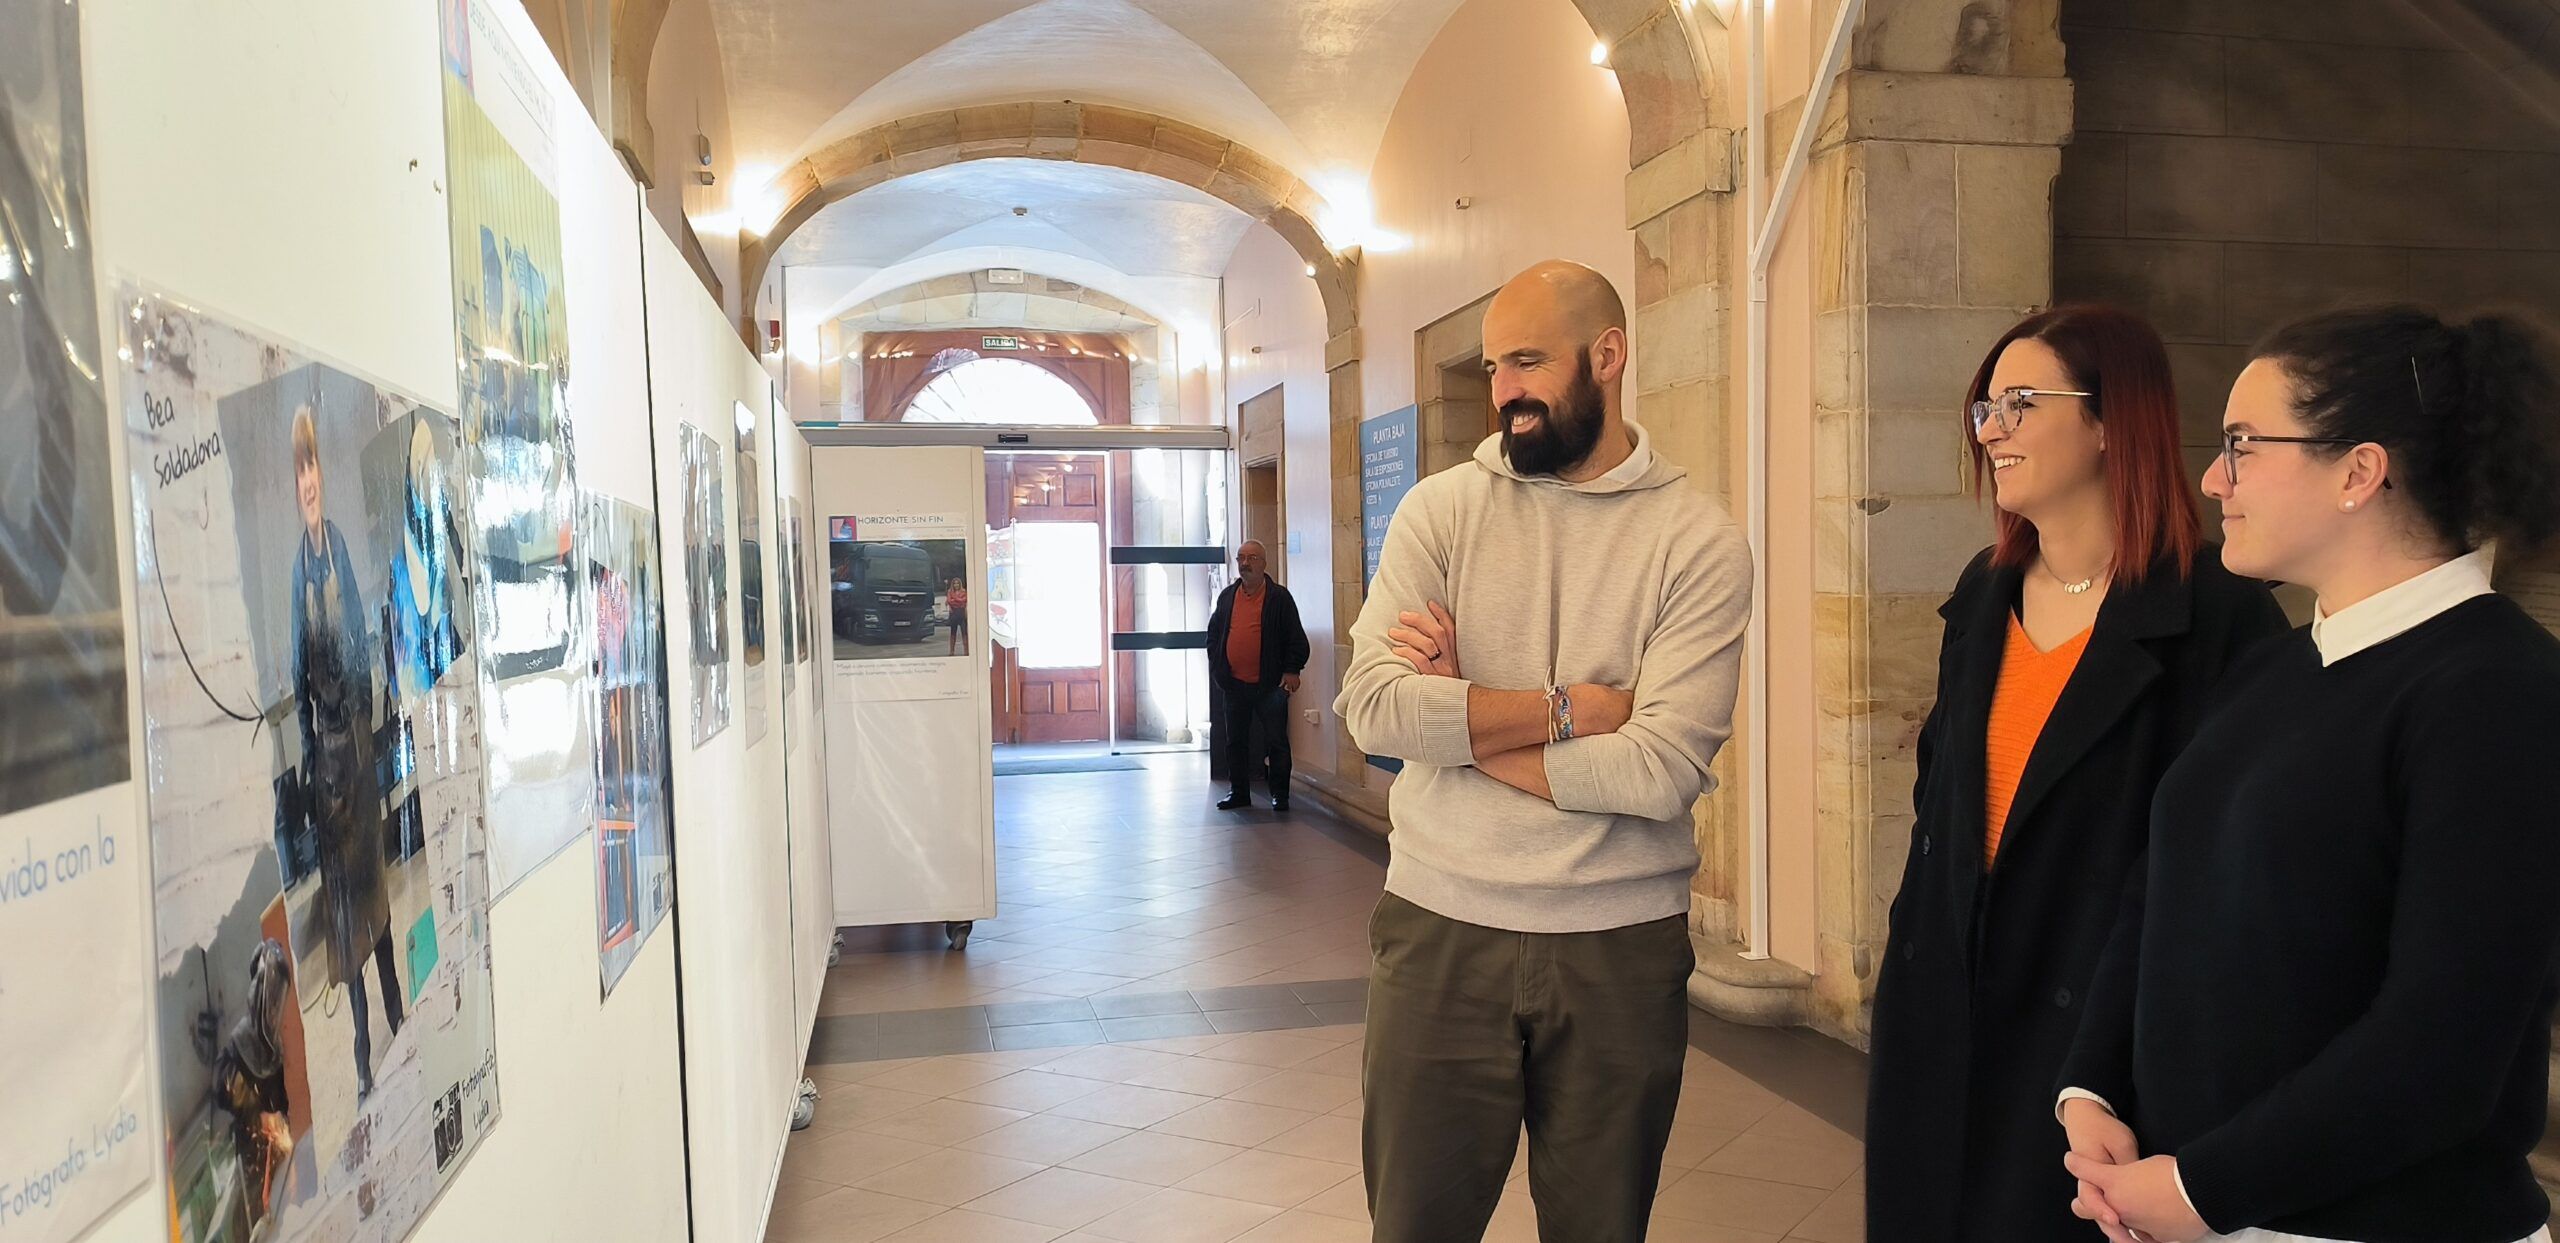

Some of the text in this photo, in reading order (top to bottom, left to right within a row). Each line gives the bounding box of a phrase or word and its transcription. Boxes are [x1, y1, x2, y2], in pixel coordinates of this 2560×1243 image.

[144, 391, 175, 430] Bea
[1392, 423, 1406, 440] BAJA
[153, 431, 221, 489] Soldadora
[857, 515, 944, 525] HORIZONTE SIN FIN
[0, 813, 115, 903] vida con la
[92, 1103, 137, 1162] Lydia
